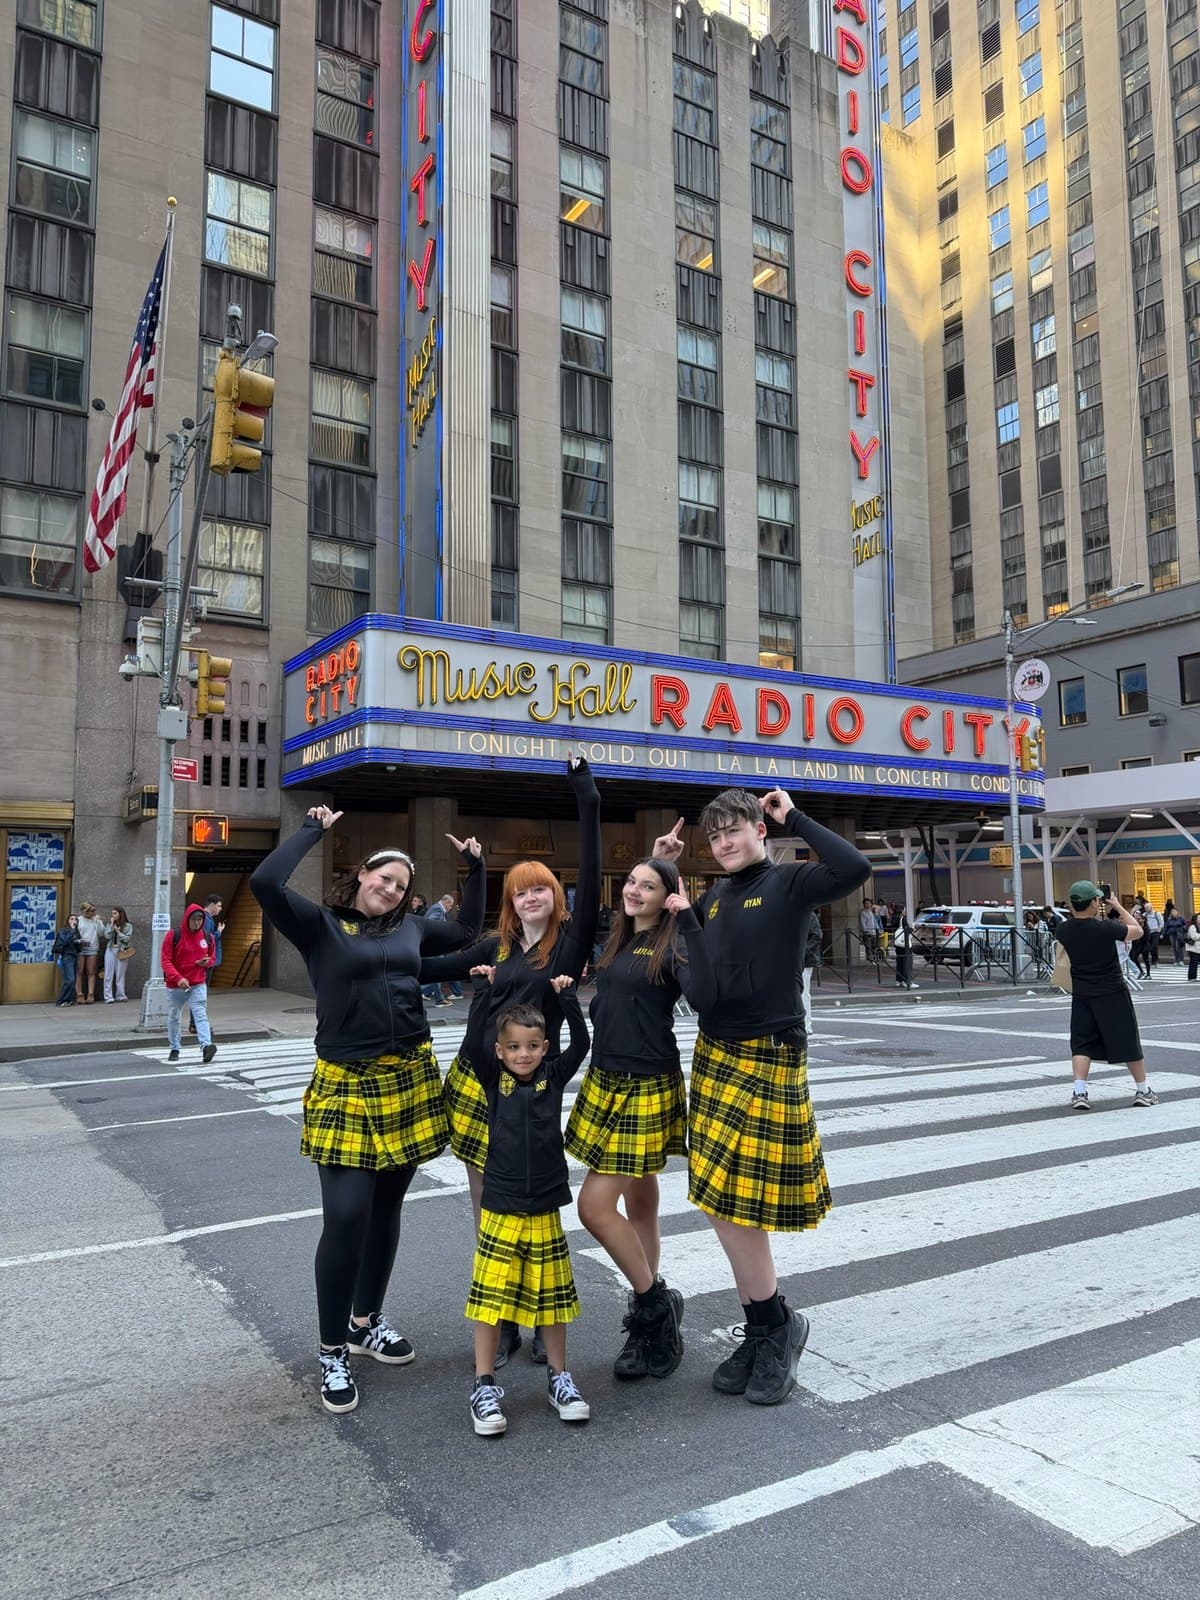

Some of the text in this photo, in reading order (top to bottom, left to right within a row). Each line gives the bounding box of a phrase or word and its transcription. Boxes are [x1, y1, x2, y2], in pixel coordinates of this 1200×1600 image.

[845, 250, 880, 479] CITY
[305, 640, 361, 692] RADIO
[305, 675, 357, 724] CITY
[398, 645, 1030, 758] Music Hall RADIO CITY
[303, 727, 361, 766] MUSIC HALL
[455, 731, 558, 758] TONIGHT
[578, 742, 634, 764] SOLD
[649, 748, 689, 768] OUT
[717, 753, 742, 771] LA
[756, 756, 779, 775] LA
[793, 759, 838, 779] LAND
[849, 764, 865, 781] IN
[876, 767, 949, 787] CONCERT
[743, 897, 763, 909] RYAN
